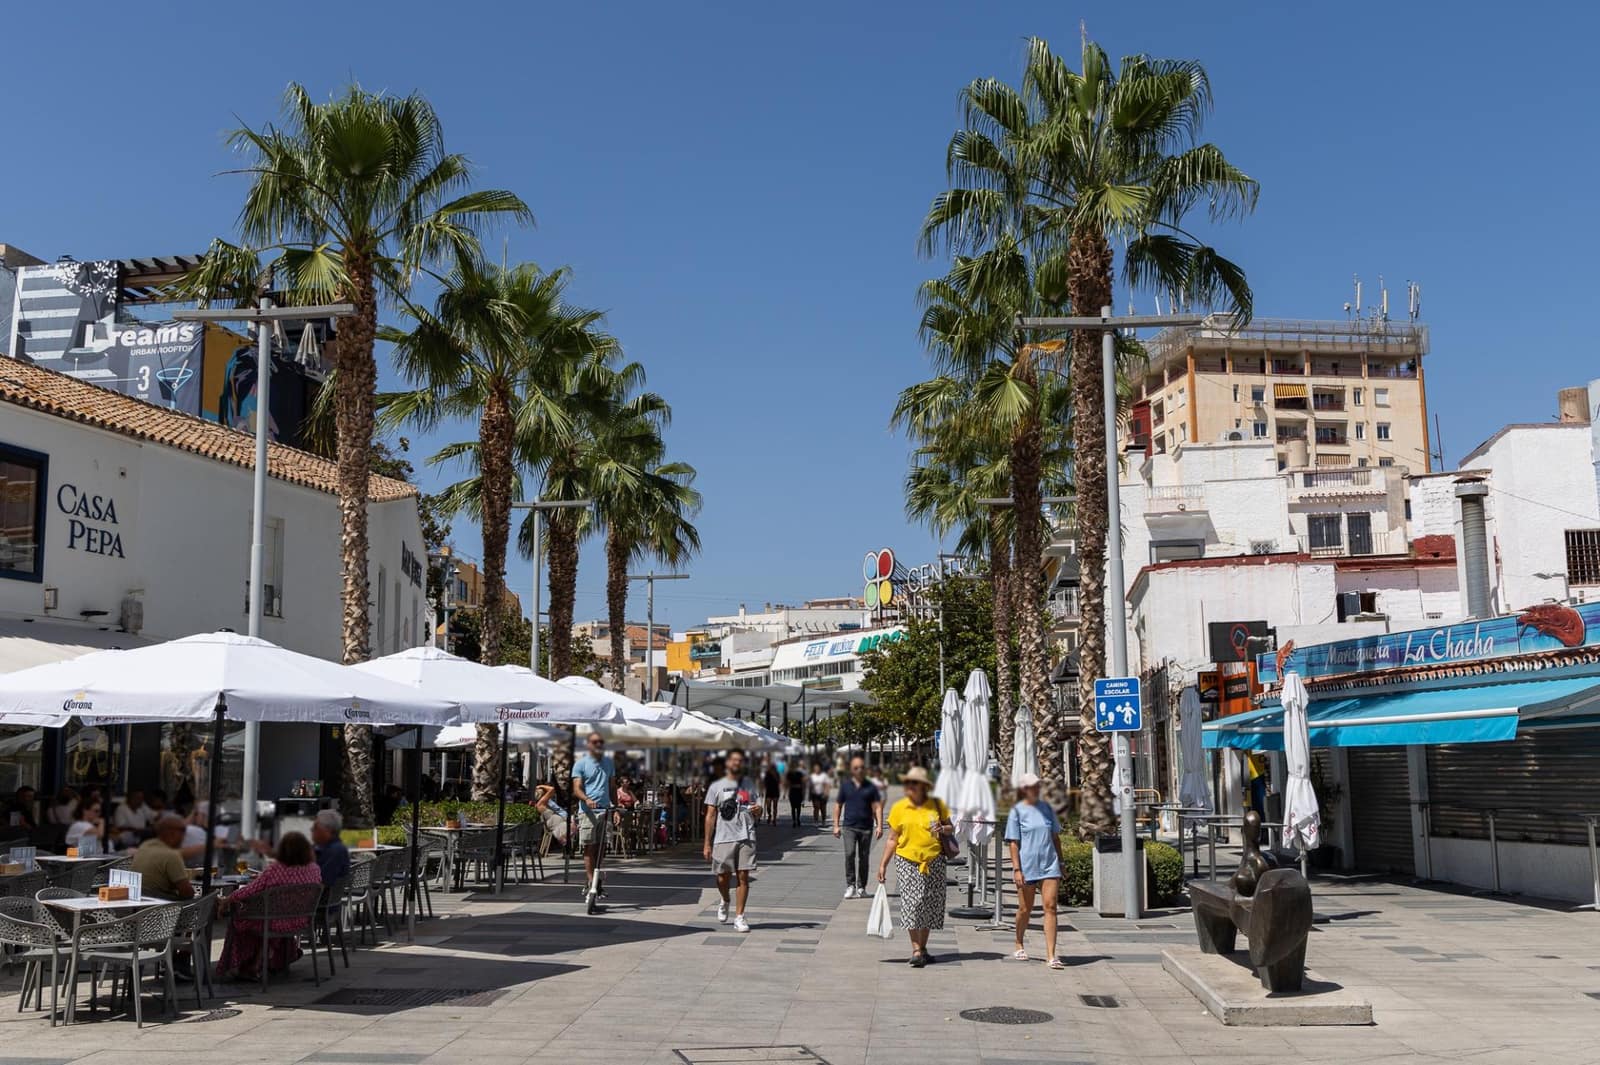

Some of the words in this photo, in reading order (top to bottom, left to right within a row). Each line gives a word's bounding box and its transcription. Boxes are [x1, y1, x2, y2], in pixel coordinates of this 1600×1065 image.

[130, 346, 157, 356] URBAN
[137, 365, 150, 392] 3
[57, 483, 119, 524] CASA
[67, 519, 126, 559] PEPA
[1404, 633, 1425, 665] La
[1429, 623, 1495, 660] Chacha
[1105, 681, 1129, 689] CAMINO
[63, 699, 93, 712] Corona
[495, 705, 550, 721] Budweiser
